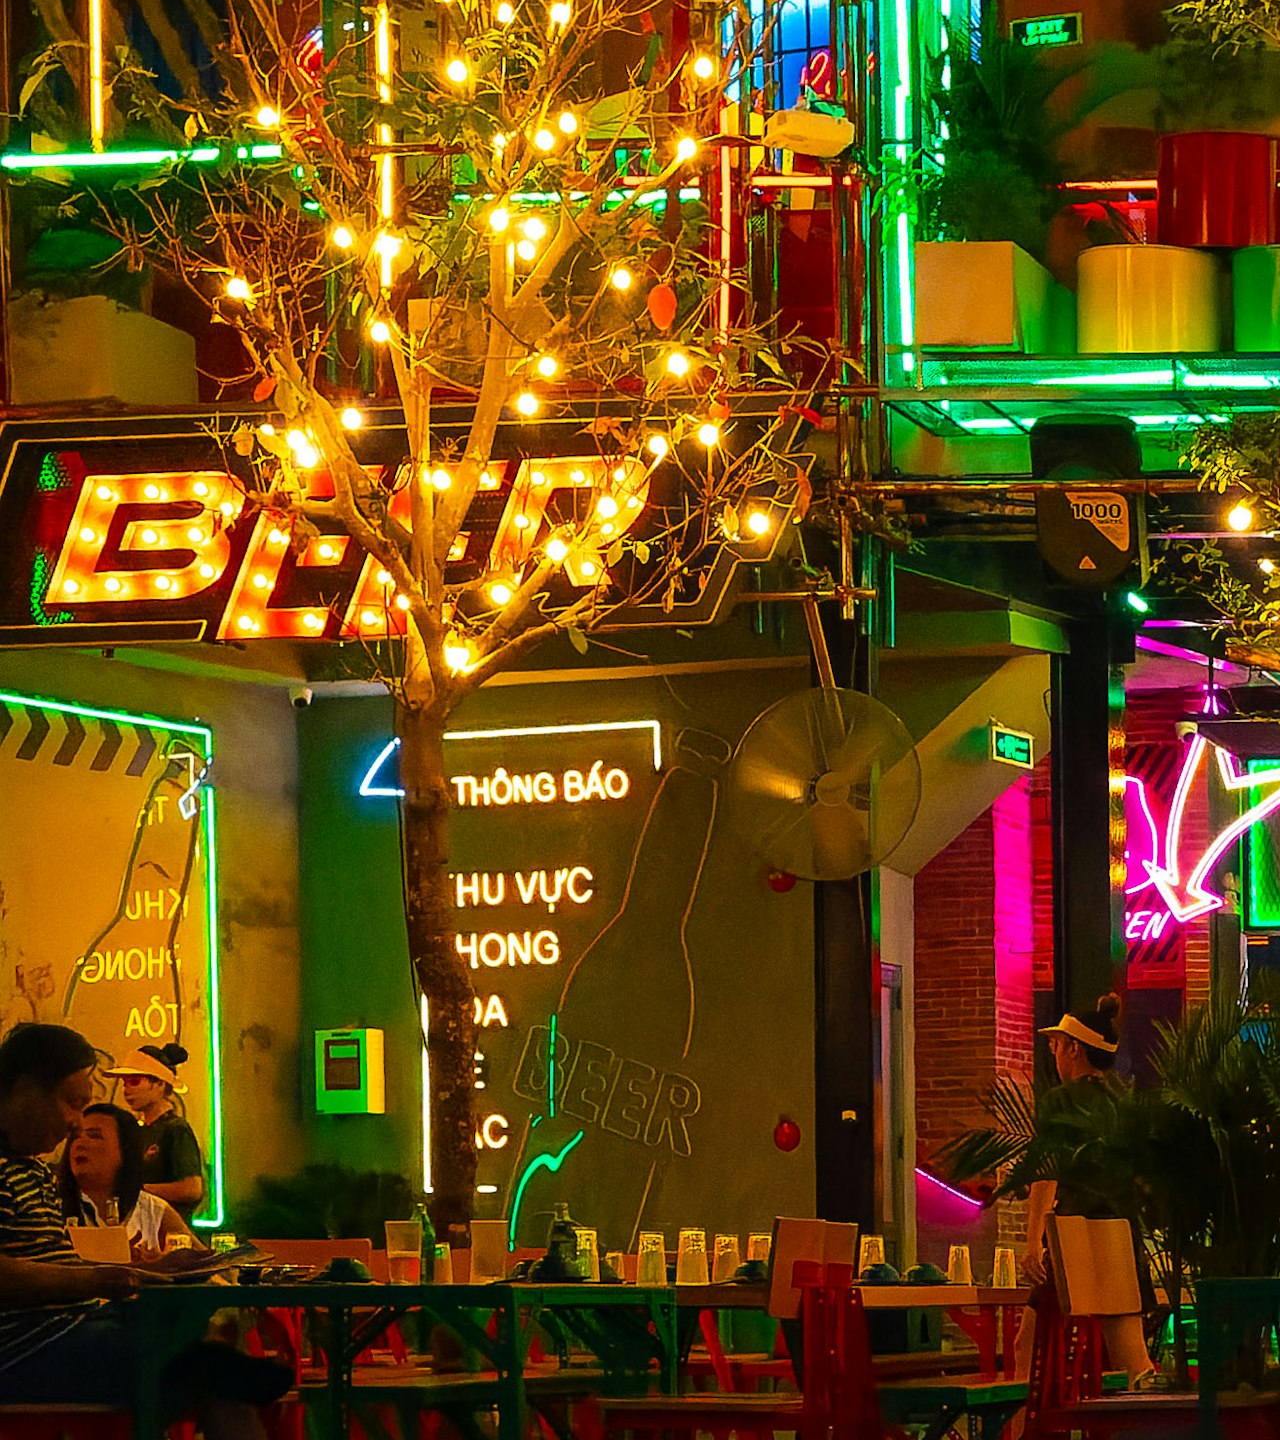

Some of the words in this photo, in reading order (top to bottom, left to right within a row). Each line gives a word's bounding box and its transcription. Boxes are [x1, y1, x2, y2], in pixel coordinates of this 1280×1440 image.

[451, 766, 557, 807] THÔNG
[563, 759, 629, 803] BÁO
[448, 871, 505, 908] HU
[514, 866, 594, 913] VỰC
[455, 930, 560, 970] HONG
[511, 1024, 702, 1158] BEER
